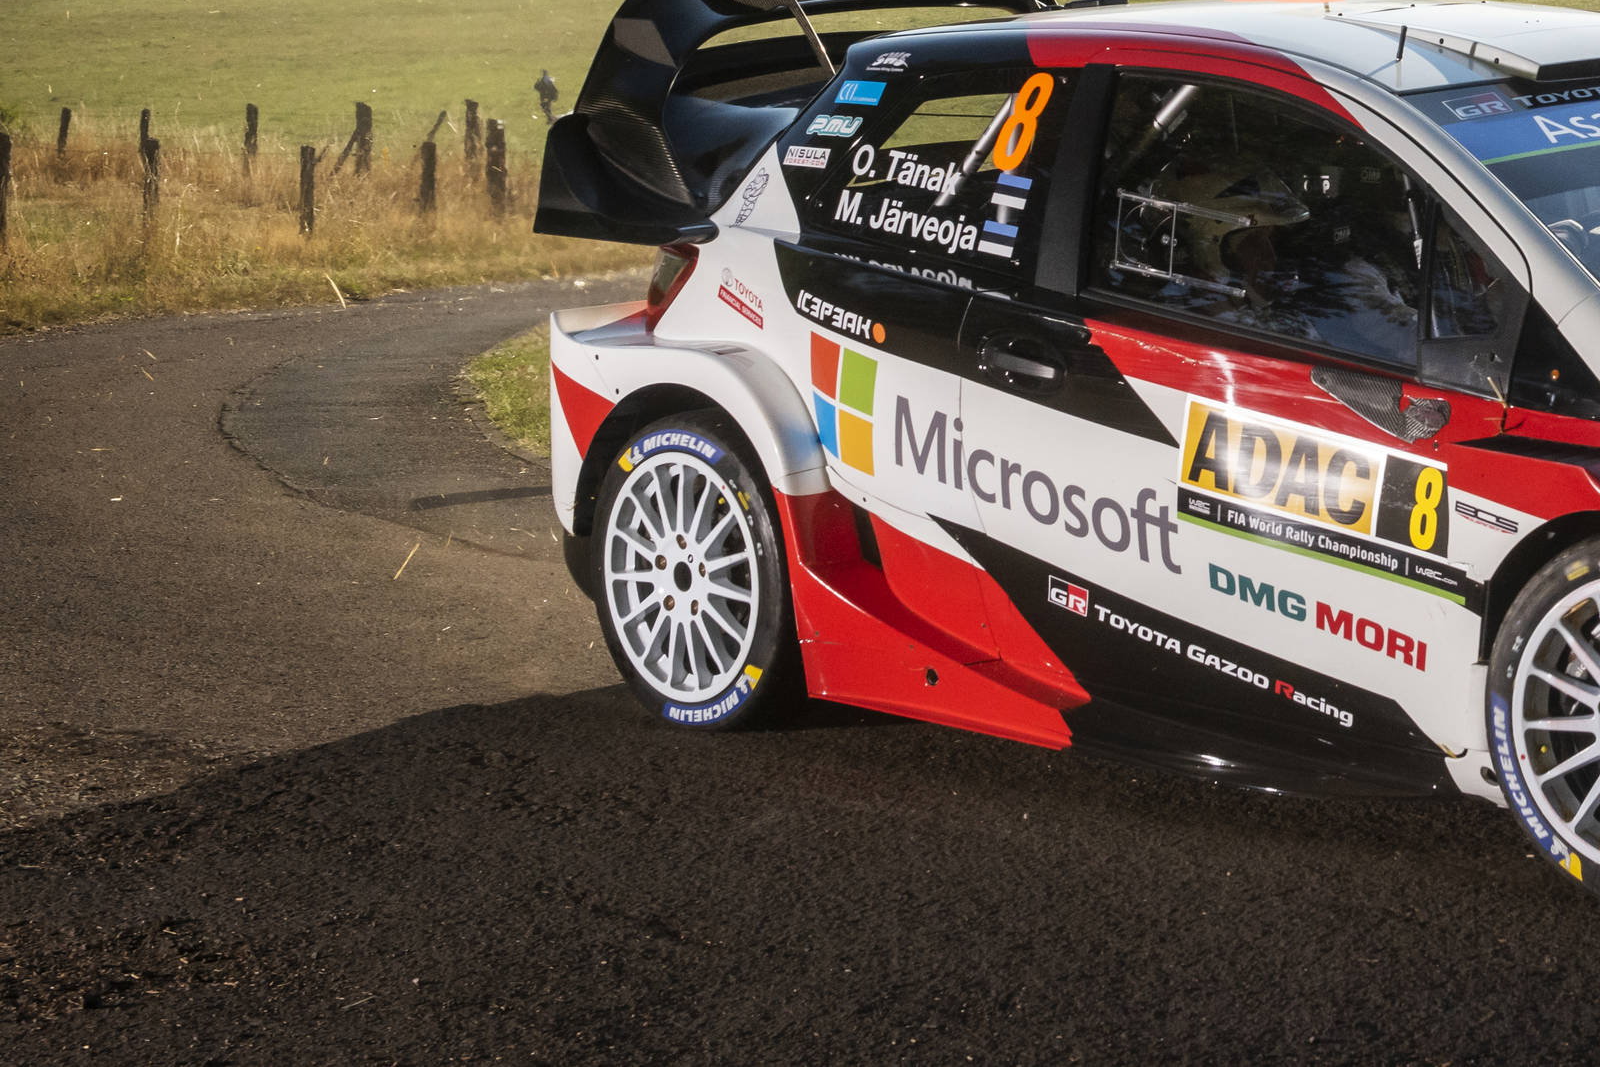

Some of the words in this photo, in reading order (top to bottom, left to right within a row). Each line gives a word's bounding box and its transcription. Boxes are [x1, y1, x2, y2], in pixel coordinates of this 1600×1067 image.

[992, 73, 1054, 171] 8
[1455, 99, 1507, 119] GR
[788, 148, 827, 161] NISULA
[852, 144, 876, 178] O.
[886, 150, 962, 195] Tänak
[834, 189, 863, 224] M.
[870, 197, 978, 254] Järveoja
[734, 277, 764, 312] TOYOTA
[642, 432, 717, 459] MICHELIN
[894, 395, 1182, 575] Microsoft
[1188, 410, 1372, 525] ADAC
[1409, 467, 1444, 551] 8
[1227, 509, 1247, 527] FIA
[1250, 515, 1283, 537] World
[1286, 525, 1315, 547] Rally
[1318, 534, 1399, 571] Championship
[1209, 562, 1307, 621] DMG
[1316, 601, 1428, 672] MORI
[1049, 586, 1087, 614] GR
[1094, 604, 1181, 655] TOYOTA
[1187, 644, 1270, 690] GAZOO
[1274, 679, 1354, 728] Racing
[669, 691, 740, 723] MICHELIN
[1493, 706, 1550, 840] MICHELIN
